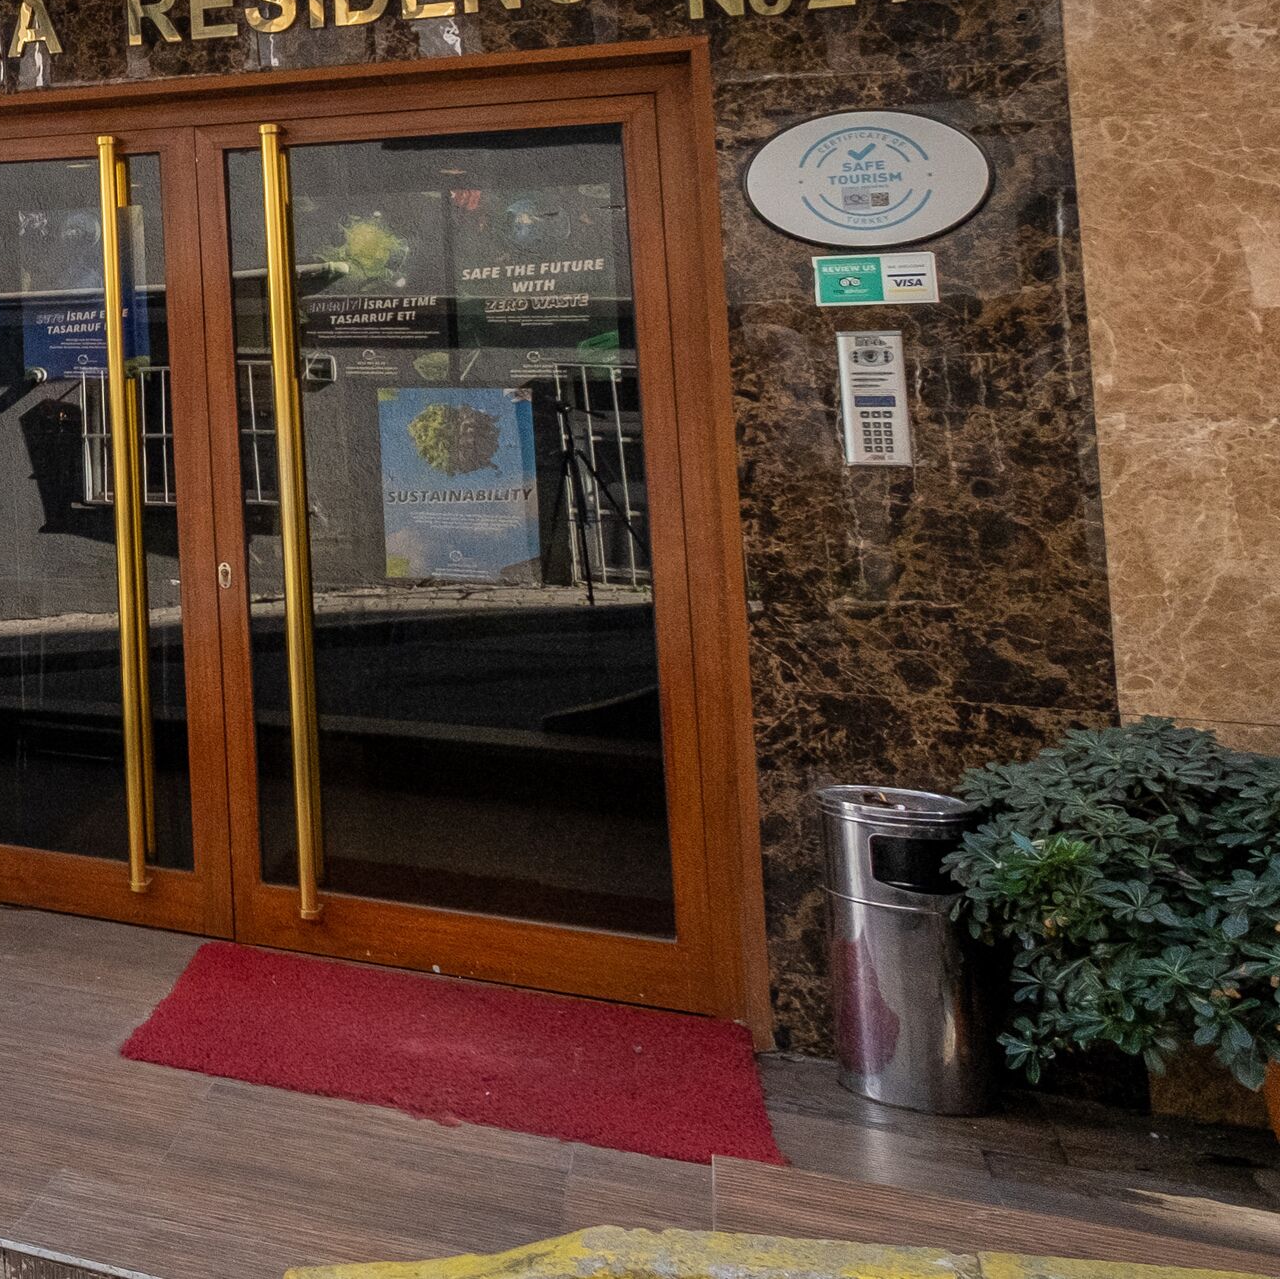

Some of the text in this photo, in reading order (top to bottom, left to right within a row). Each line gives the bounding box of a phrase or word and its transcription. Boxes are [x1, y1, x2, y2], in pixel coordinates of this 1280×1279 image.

[817, 131, 888, 154] CERTIFICATE
[842, 160, 885, 172] SAFE
[828, 172, 902, 185] TOURISM
[846, 215, 889, 224] TURKEY
[462, 258, 605, 280] SAFE THE FUTURE
[822, 264, 859, 273] REVIEW
[862, 264, 877, 272] US
[512, 279, 555, 293] WITH
[893, 278, 923, 287] VISA
[363, 298, 399, 310] İSRAF
[403, 296, 437, 307] ETME
[485, 293, 589, 313] ZERO WASTE
[66, 311, 96, 322] İSRAF
[99, 308, 128, 319] EE
[330, 311, 416, 325] TASARRUF ET!
[47, 322, 101, 334] TASARRUF
[386, 488, 533, 504] SUSTAINABILITY
